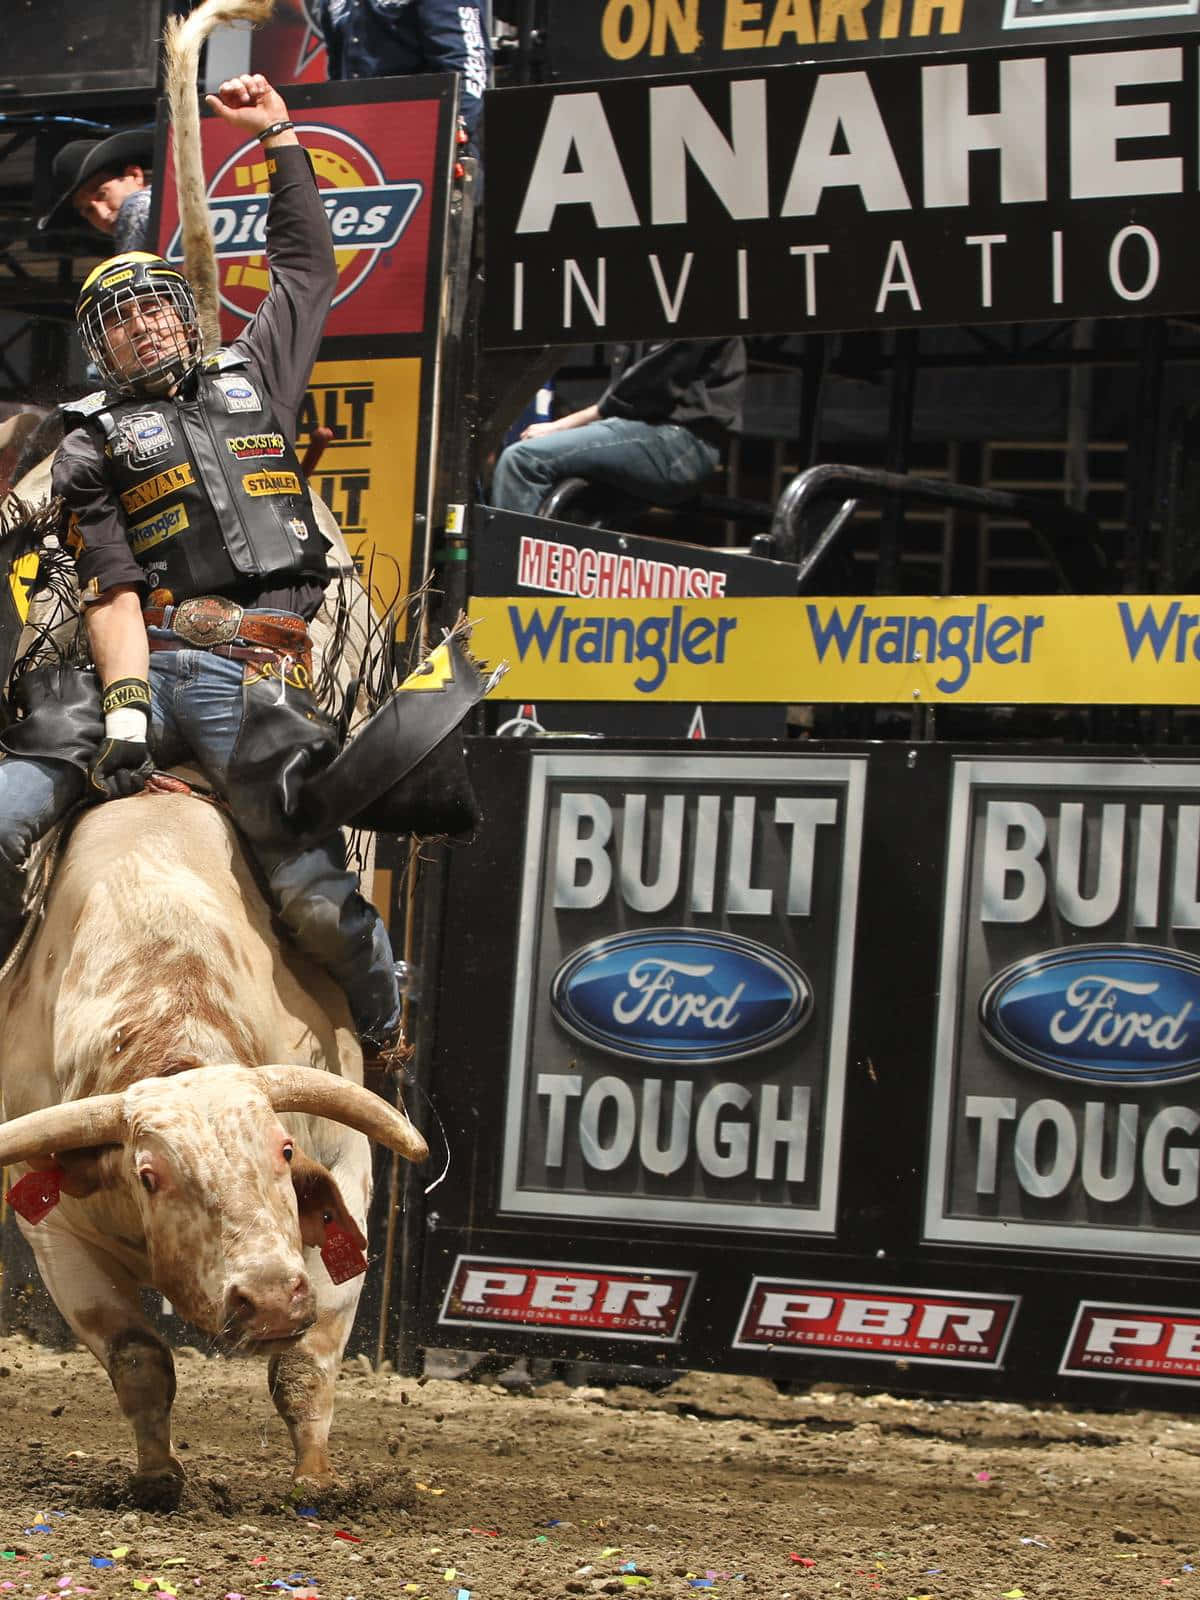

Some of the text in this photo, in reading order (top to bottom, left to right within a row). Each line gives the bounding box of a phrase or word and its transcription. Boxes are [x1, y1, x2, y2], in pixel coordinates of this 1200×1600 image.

[601, 0, 962, 60] ON EARTH
[516, 47, 1200, 234] ANAHE
[513, 225, 1161, 331] INVITATIO
[296, 388, 374, 440] ALT
[518, 536, 726, 599] MERCHANDISE
[507, 604, 738, 694] Wrangler
[806, 603, 1045, 695] Wrangler
[553, 793, 838, 916] BUILT
[612, 957, 745, 1030] Ford
[1049, 975, 1189, 1051] Ford
[536, 1073, 812, 1183] TOUGH
[461, 1270, 673, 1318] PBR
[461, 1305, 667, 1329] PROFESSIONAL BULL RIDERS
[758, 1292, 995, 1343] PBR
[755, 1328, 989, 1355] PROFESSIONAL BULL RIDERS
